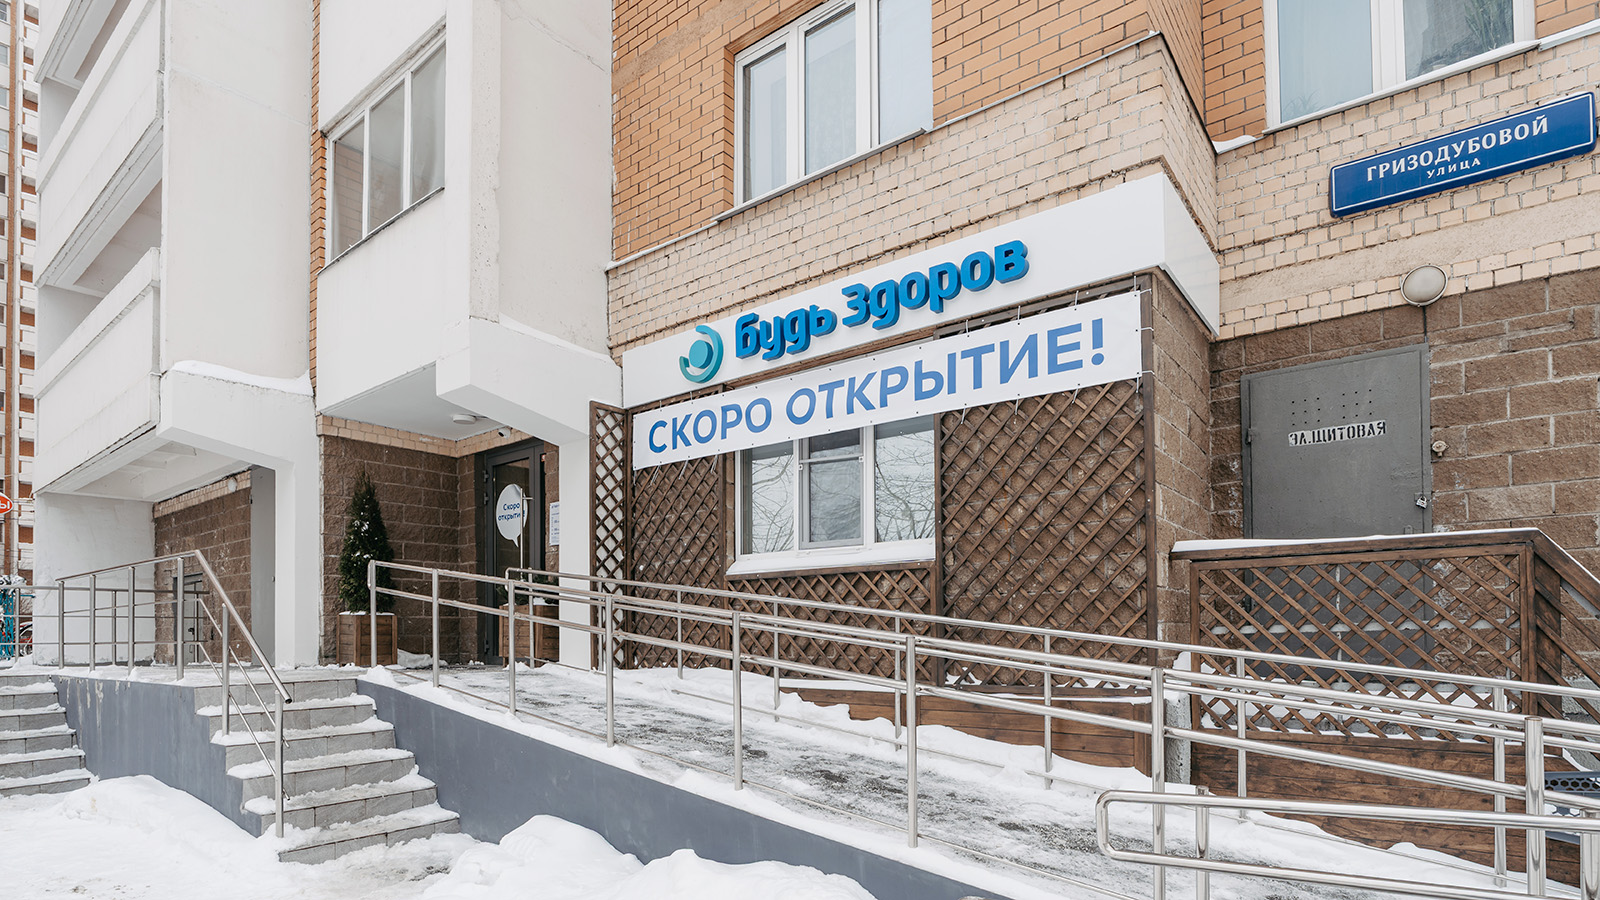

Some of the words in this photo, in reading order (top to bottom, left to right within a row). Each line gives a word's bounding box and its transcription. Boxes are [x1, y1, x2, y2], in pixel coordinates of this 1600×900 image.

[1366, 114, 1548, 182] ГРИЗОДУБОВОЙ
[1426, 157, 1481, 179] УЛИЦА
[734, 304, 838, 361] Будь
[648, 397, 772, 454] СКОРО
[785, 318, 1105, 425] ОТКРЫТИЕ!
[503, 503, 520, 511] Скоро
